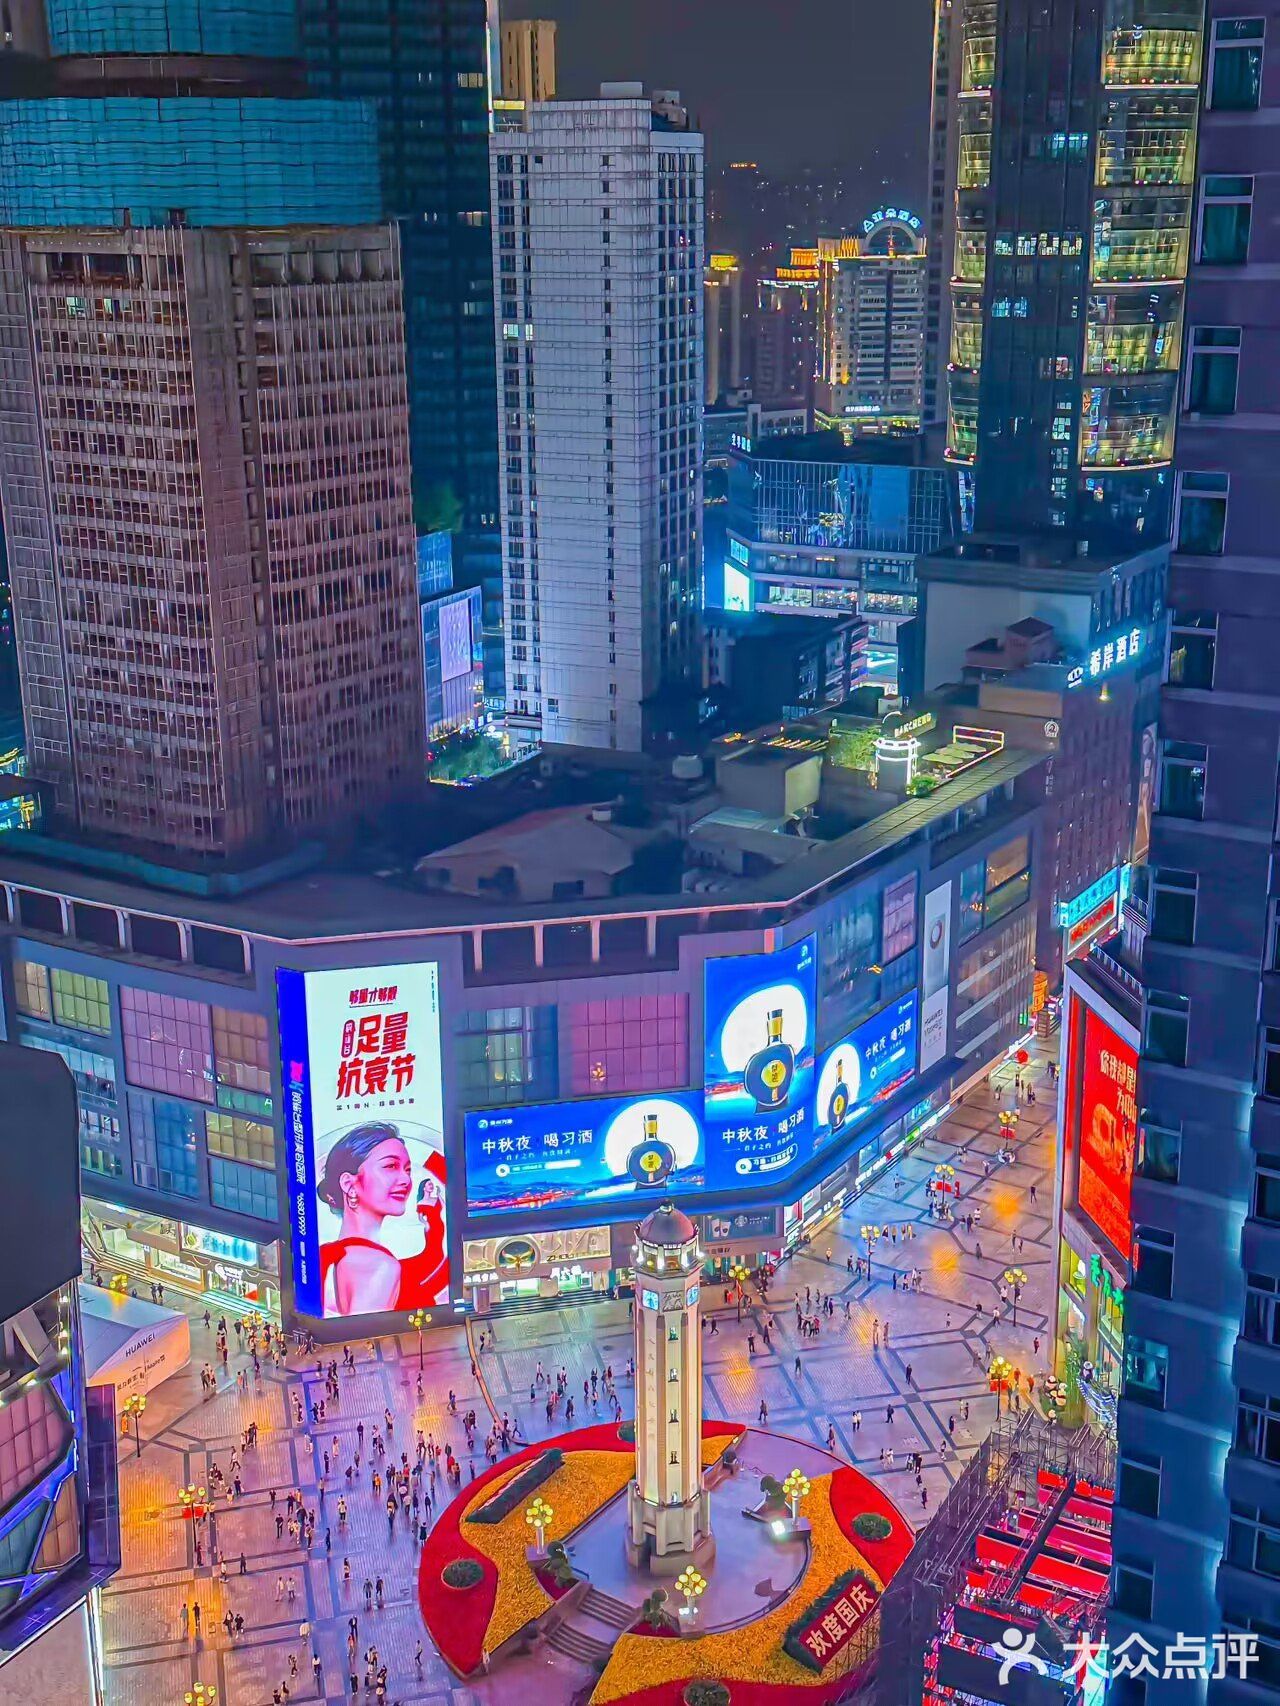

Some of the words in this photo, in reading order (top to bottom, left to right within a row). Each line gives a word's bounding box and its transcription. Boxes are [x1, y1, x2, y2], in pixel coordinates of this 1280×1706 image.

[1089, 628, 1141, 676] 希岸酒店
[355, 1011, 409, 1057] 足量
[336, 1053, 417, 1100] 抗衰节
[1100, 1049, 1136, 1095] 你我都是
[481, 1134, 532, 1155] 中秋夜
[543, 1129, 593, 1148] 喝习酒
[722, 1125, 769, 1144] 中秋夜
[778, 1107, 805, 1134] 喝习酒
[125, 1333, 155, 1357] HUAWEI
[806, 1583, 875, 1658] 欢度国庆
